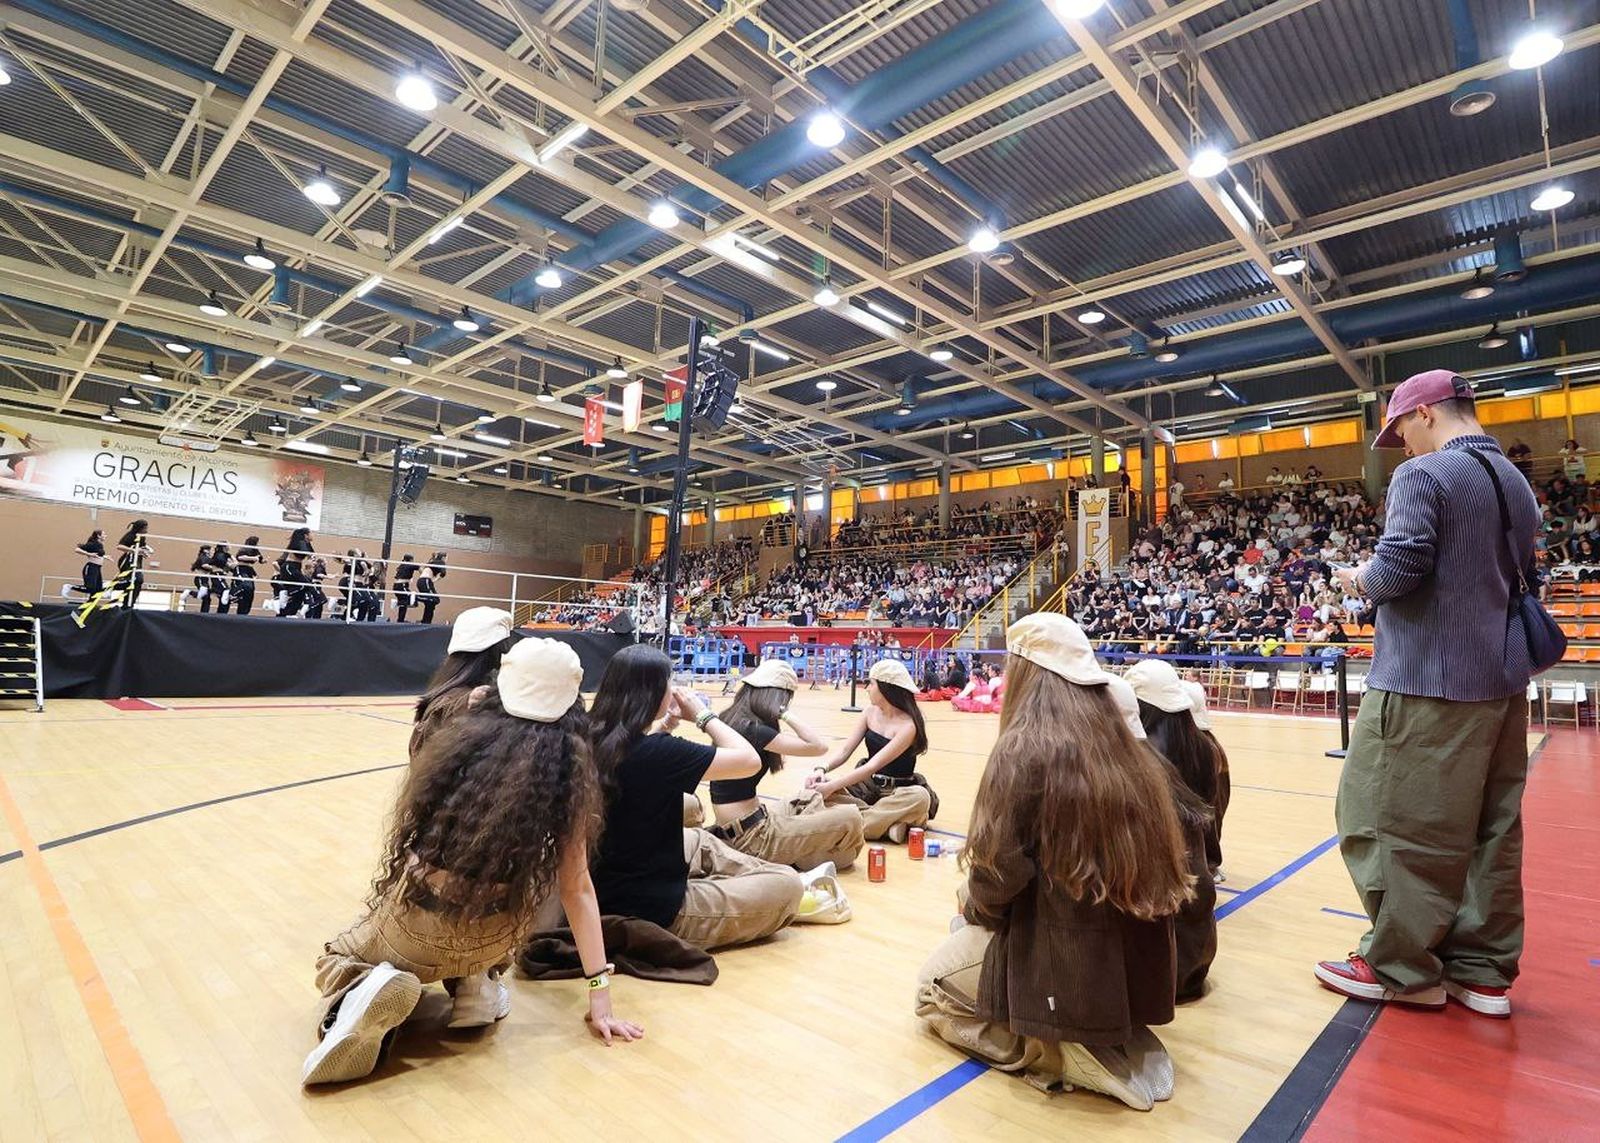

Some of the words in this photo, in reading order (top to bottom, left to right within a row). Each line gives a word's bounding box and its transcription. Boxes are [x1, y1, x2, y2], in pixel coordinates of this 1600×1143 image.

[114, 440, 184, 460] Ayuntamiento
[93, 452, 239, 495] GRACIAS
[73, 484, 140, 505] PREMIO
[142, 498, 188, 510] FOMENTO
[190, 504, 205, 514] DEL
[209, 506, 247, 518] DEPORTE
[1086, 521, 1101, 556] F
